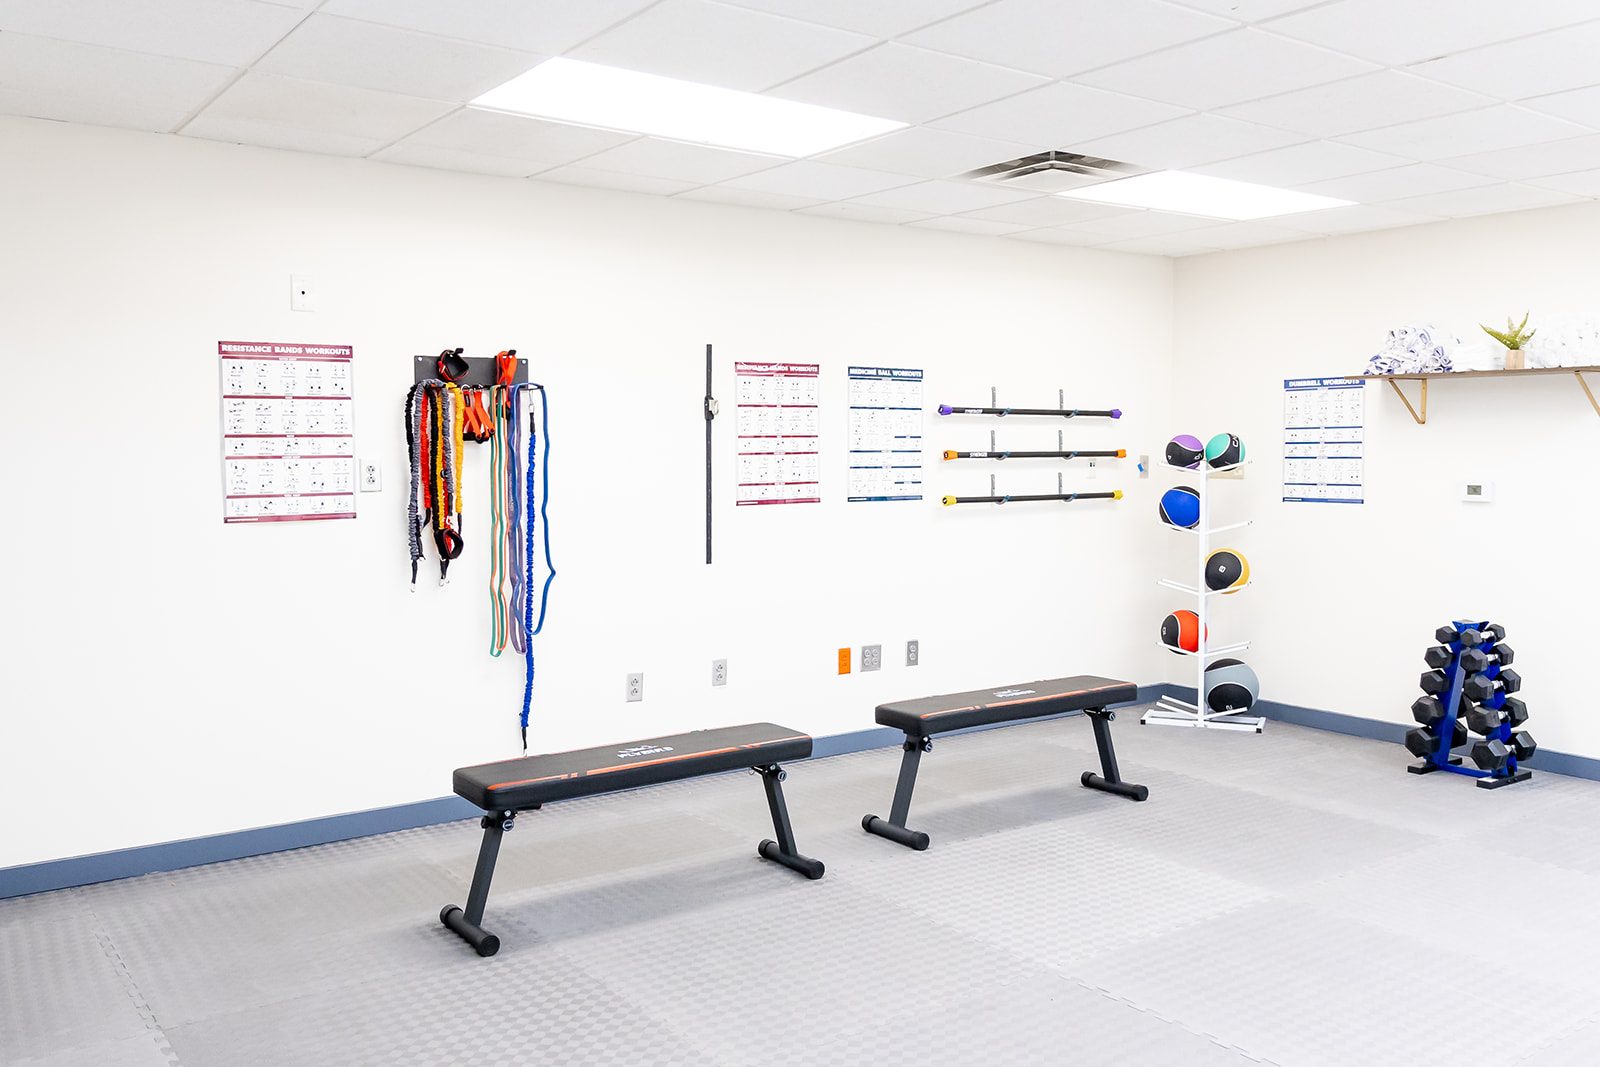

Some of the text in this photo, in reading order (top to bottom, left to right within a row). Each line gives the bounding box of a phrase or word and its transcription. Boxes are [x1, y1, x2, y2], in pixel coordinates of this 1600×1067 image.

[222, 344, 350, 355] RESISTANCE BANDS WORKOUTS
